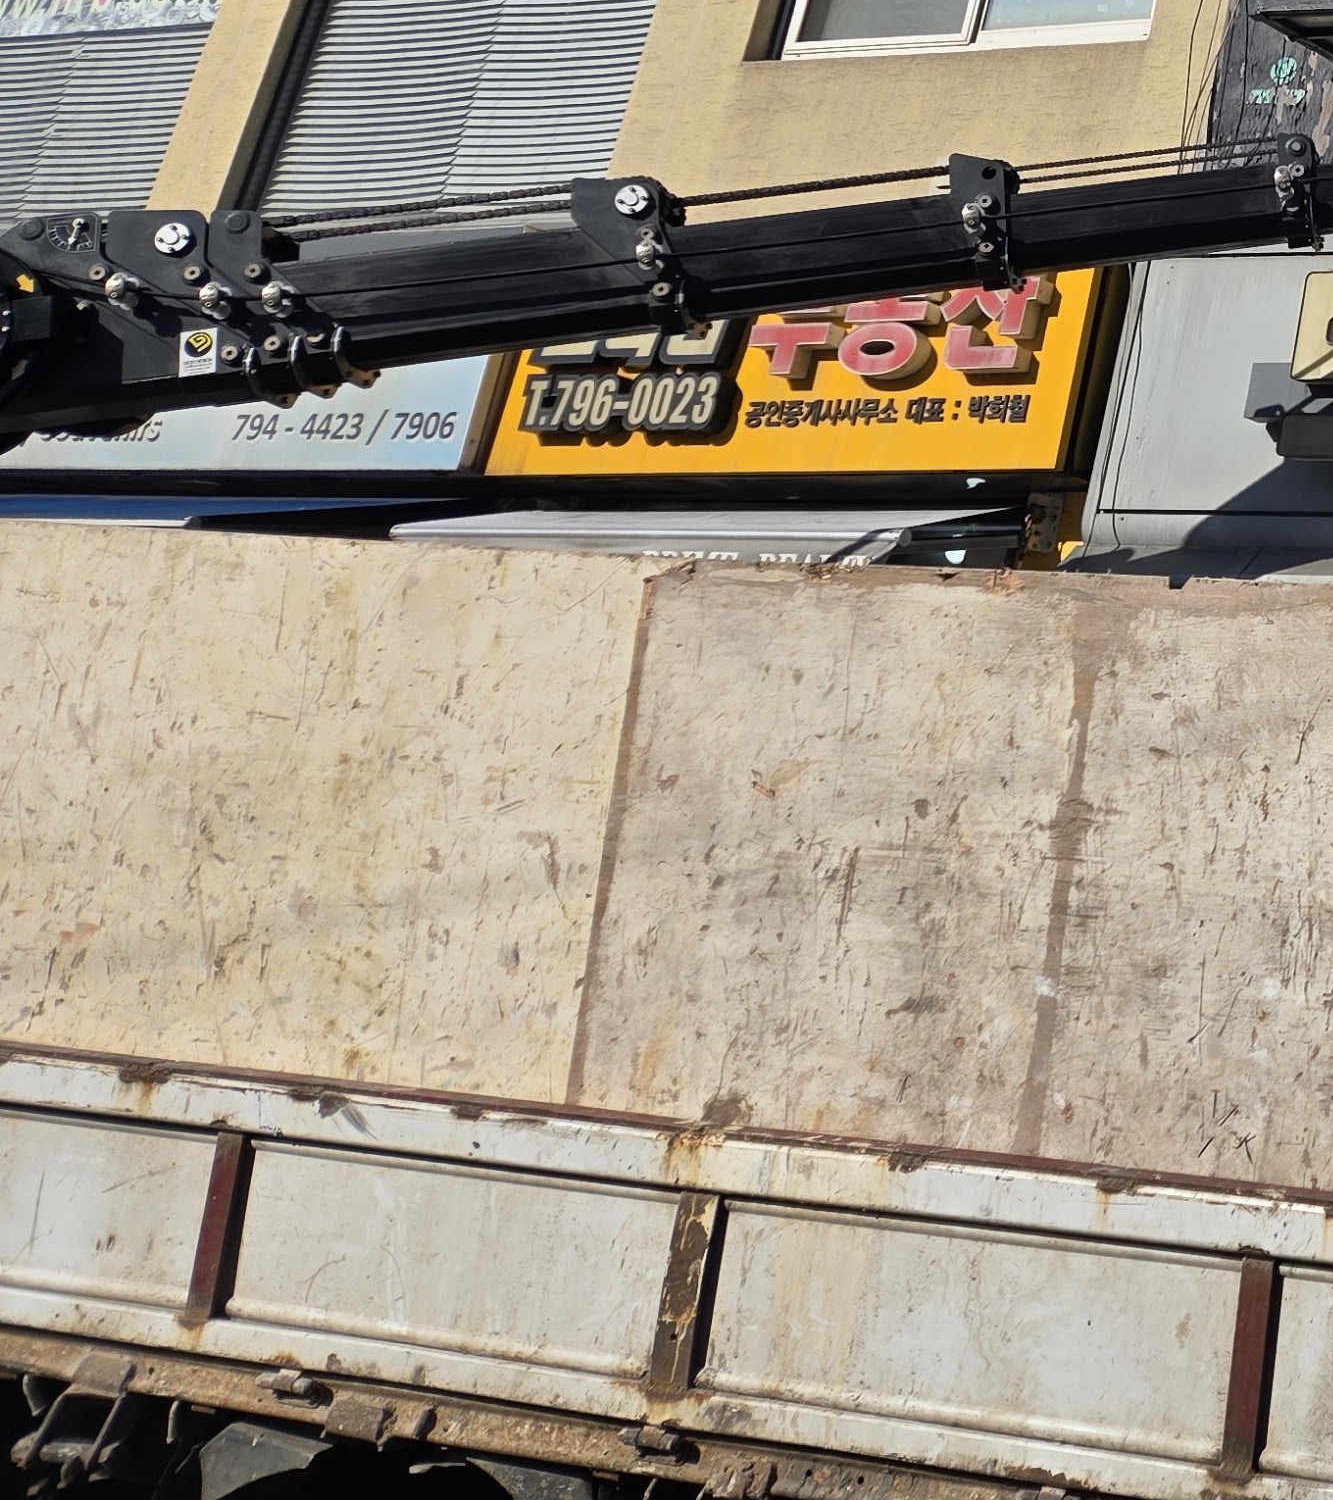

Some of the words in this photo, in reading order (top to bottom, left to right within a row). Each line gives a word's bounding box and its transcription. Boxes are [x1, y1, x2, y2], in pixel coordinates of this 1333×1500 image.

[524, 376, 719, 427] T.796-0023
[745, 397, 897, 428] 공인중개사사무소
[905, 396, 946, 424] 대표
[231, 413, 280, 442] 794
[299, 412, 365, 441] 4423
[389, 411, 458, 440] 7906
